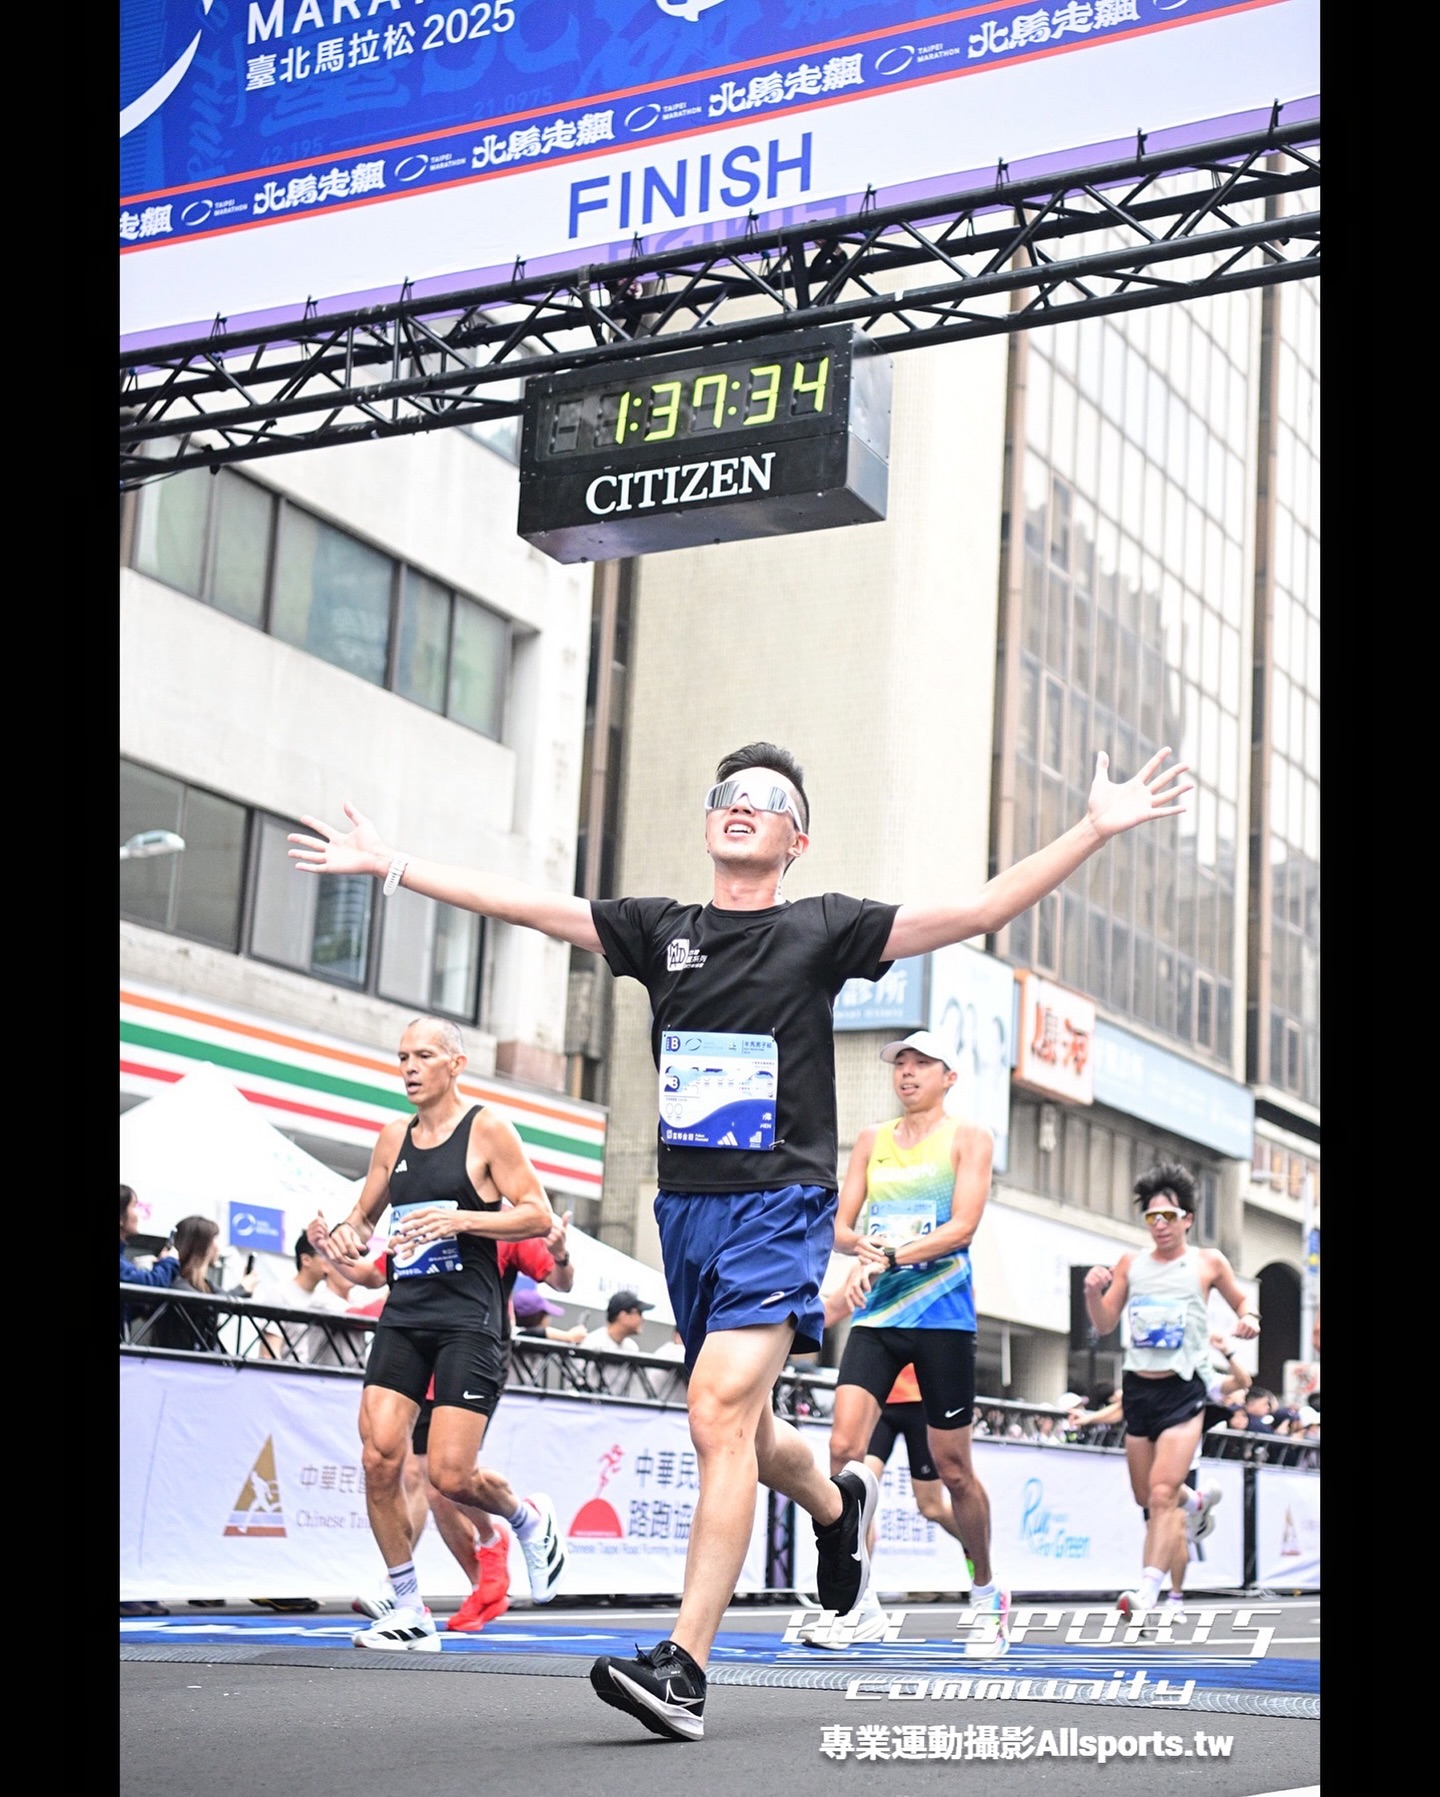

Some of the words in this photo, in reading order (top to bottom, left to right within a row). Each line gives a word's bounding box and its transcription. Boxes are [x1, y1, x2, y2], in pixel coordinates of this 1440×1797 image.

[245, 21, 416, 91] 臺北馬拉松
[421, 0, 516, 51] 2025
[917, 43, 943, 55] TAIPEI
[917, 47, 960, 63] MARATHON
[708, 52, 865, 117] 北馬走飆
[662, 102, 687, 113] TAIPEI
[662, 106, 702, 121] MARATHON
[471, 109, 616, 169] 北馬走飆
[430, 153, 452, 164] TAIPEI
[430, 157, 467, 172] MARATHON
[252, 159, 386, 215] 北馬走飆
[568, 132, 814, 239] FINISH
[214, 199, 235, 210] TAIPEI
[214, 203, 248, 217] MARATHON
[615, 356, 830, 445] 1:37:34
[585, 451, 777, 515] CITIZEN
[833, 968, 908, 1008] 診所
